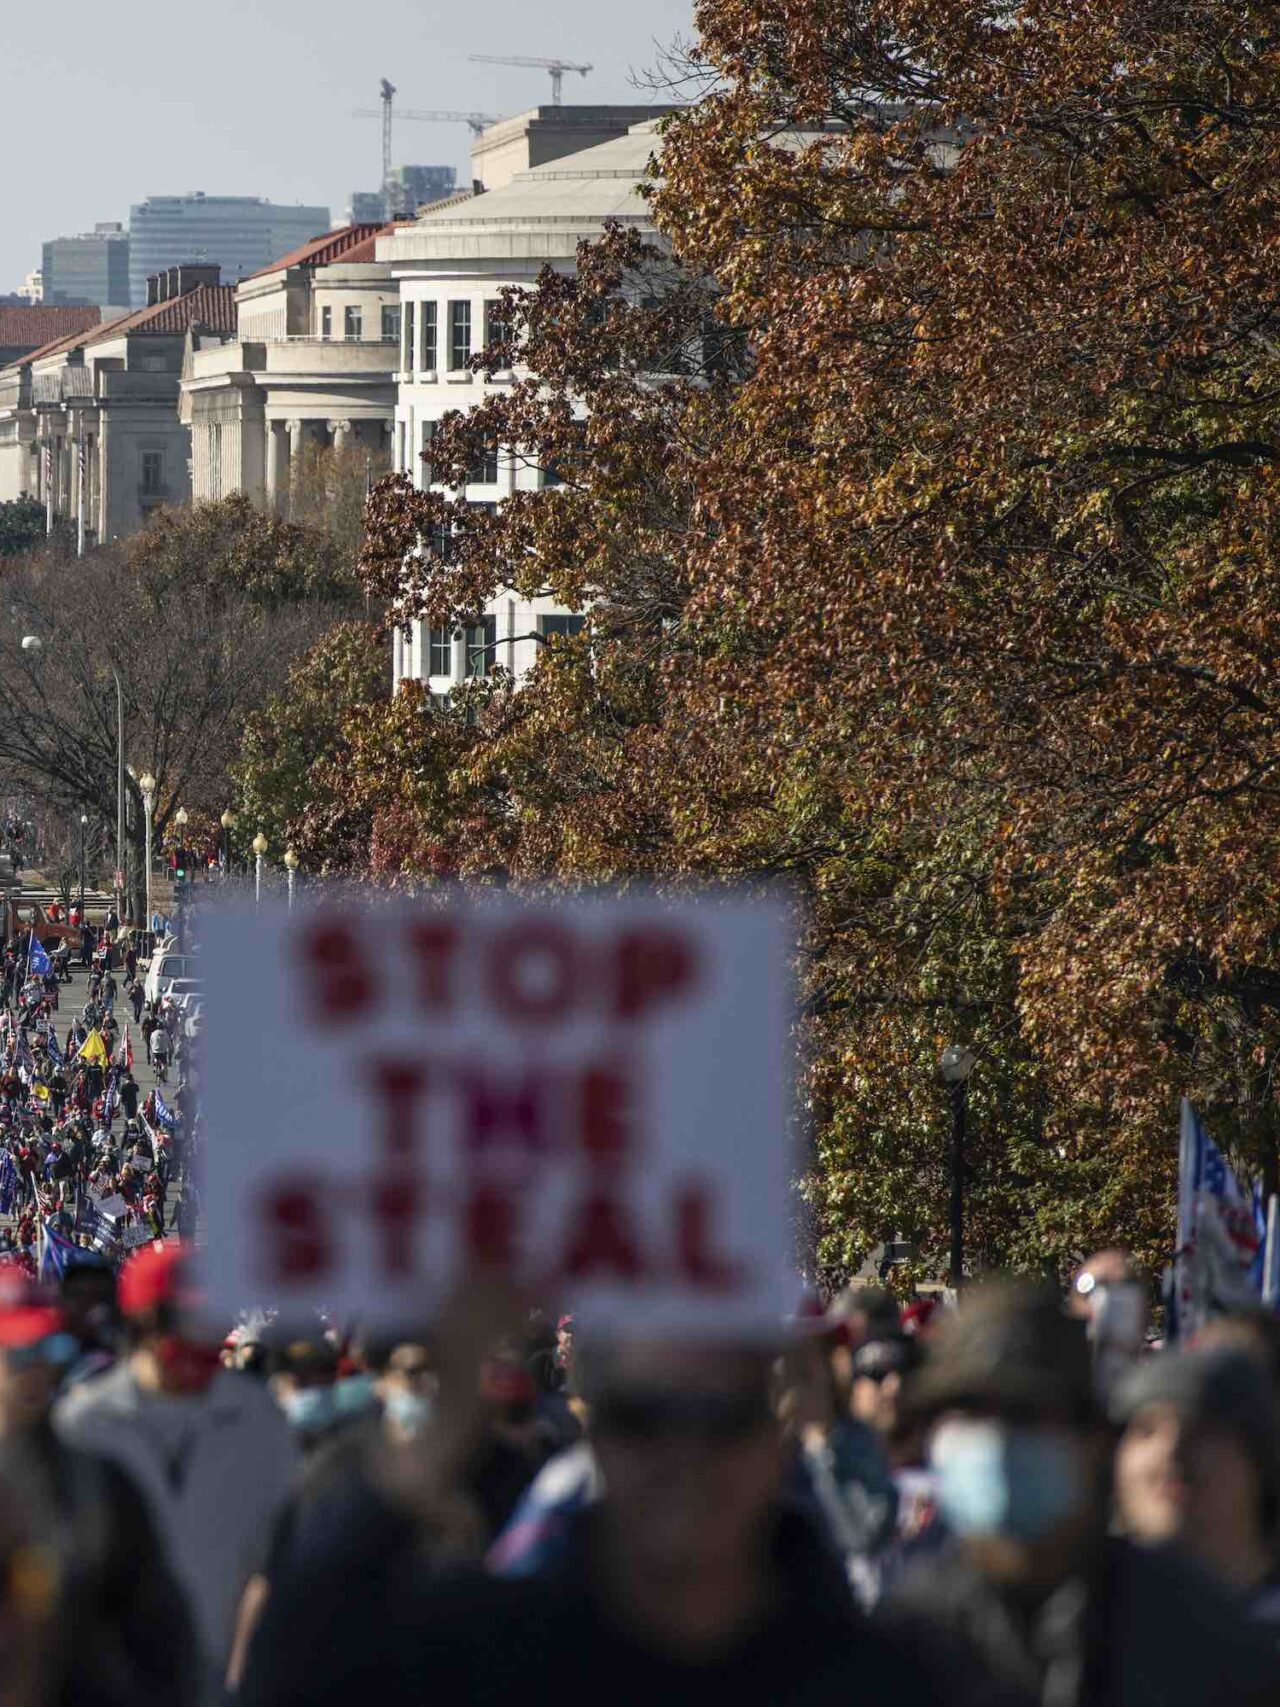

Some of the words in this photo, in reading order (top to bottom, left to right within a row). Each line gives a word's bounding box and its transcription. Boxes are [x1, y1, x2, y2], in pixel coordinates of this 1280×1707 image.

[293, 912, 705, 1030] STOP
[362, 1052, 635, 1166] THE
[254, 1180, 748, 1298] STEAL
